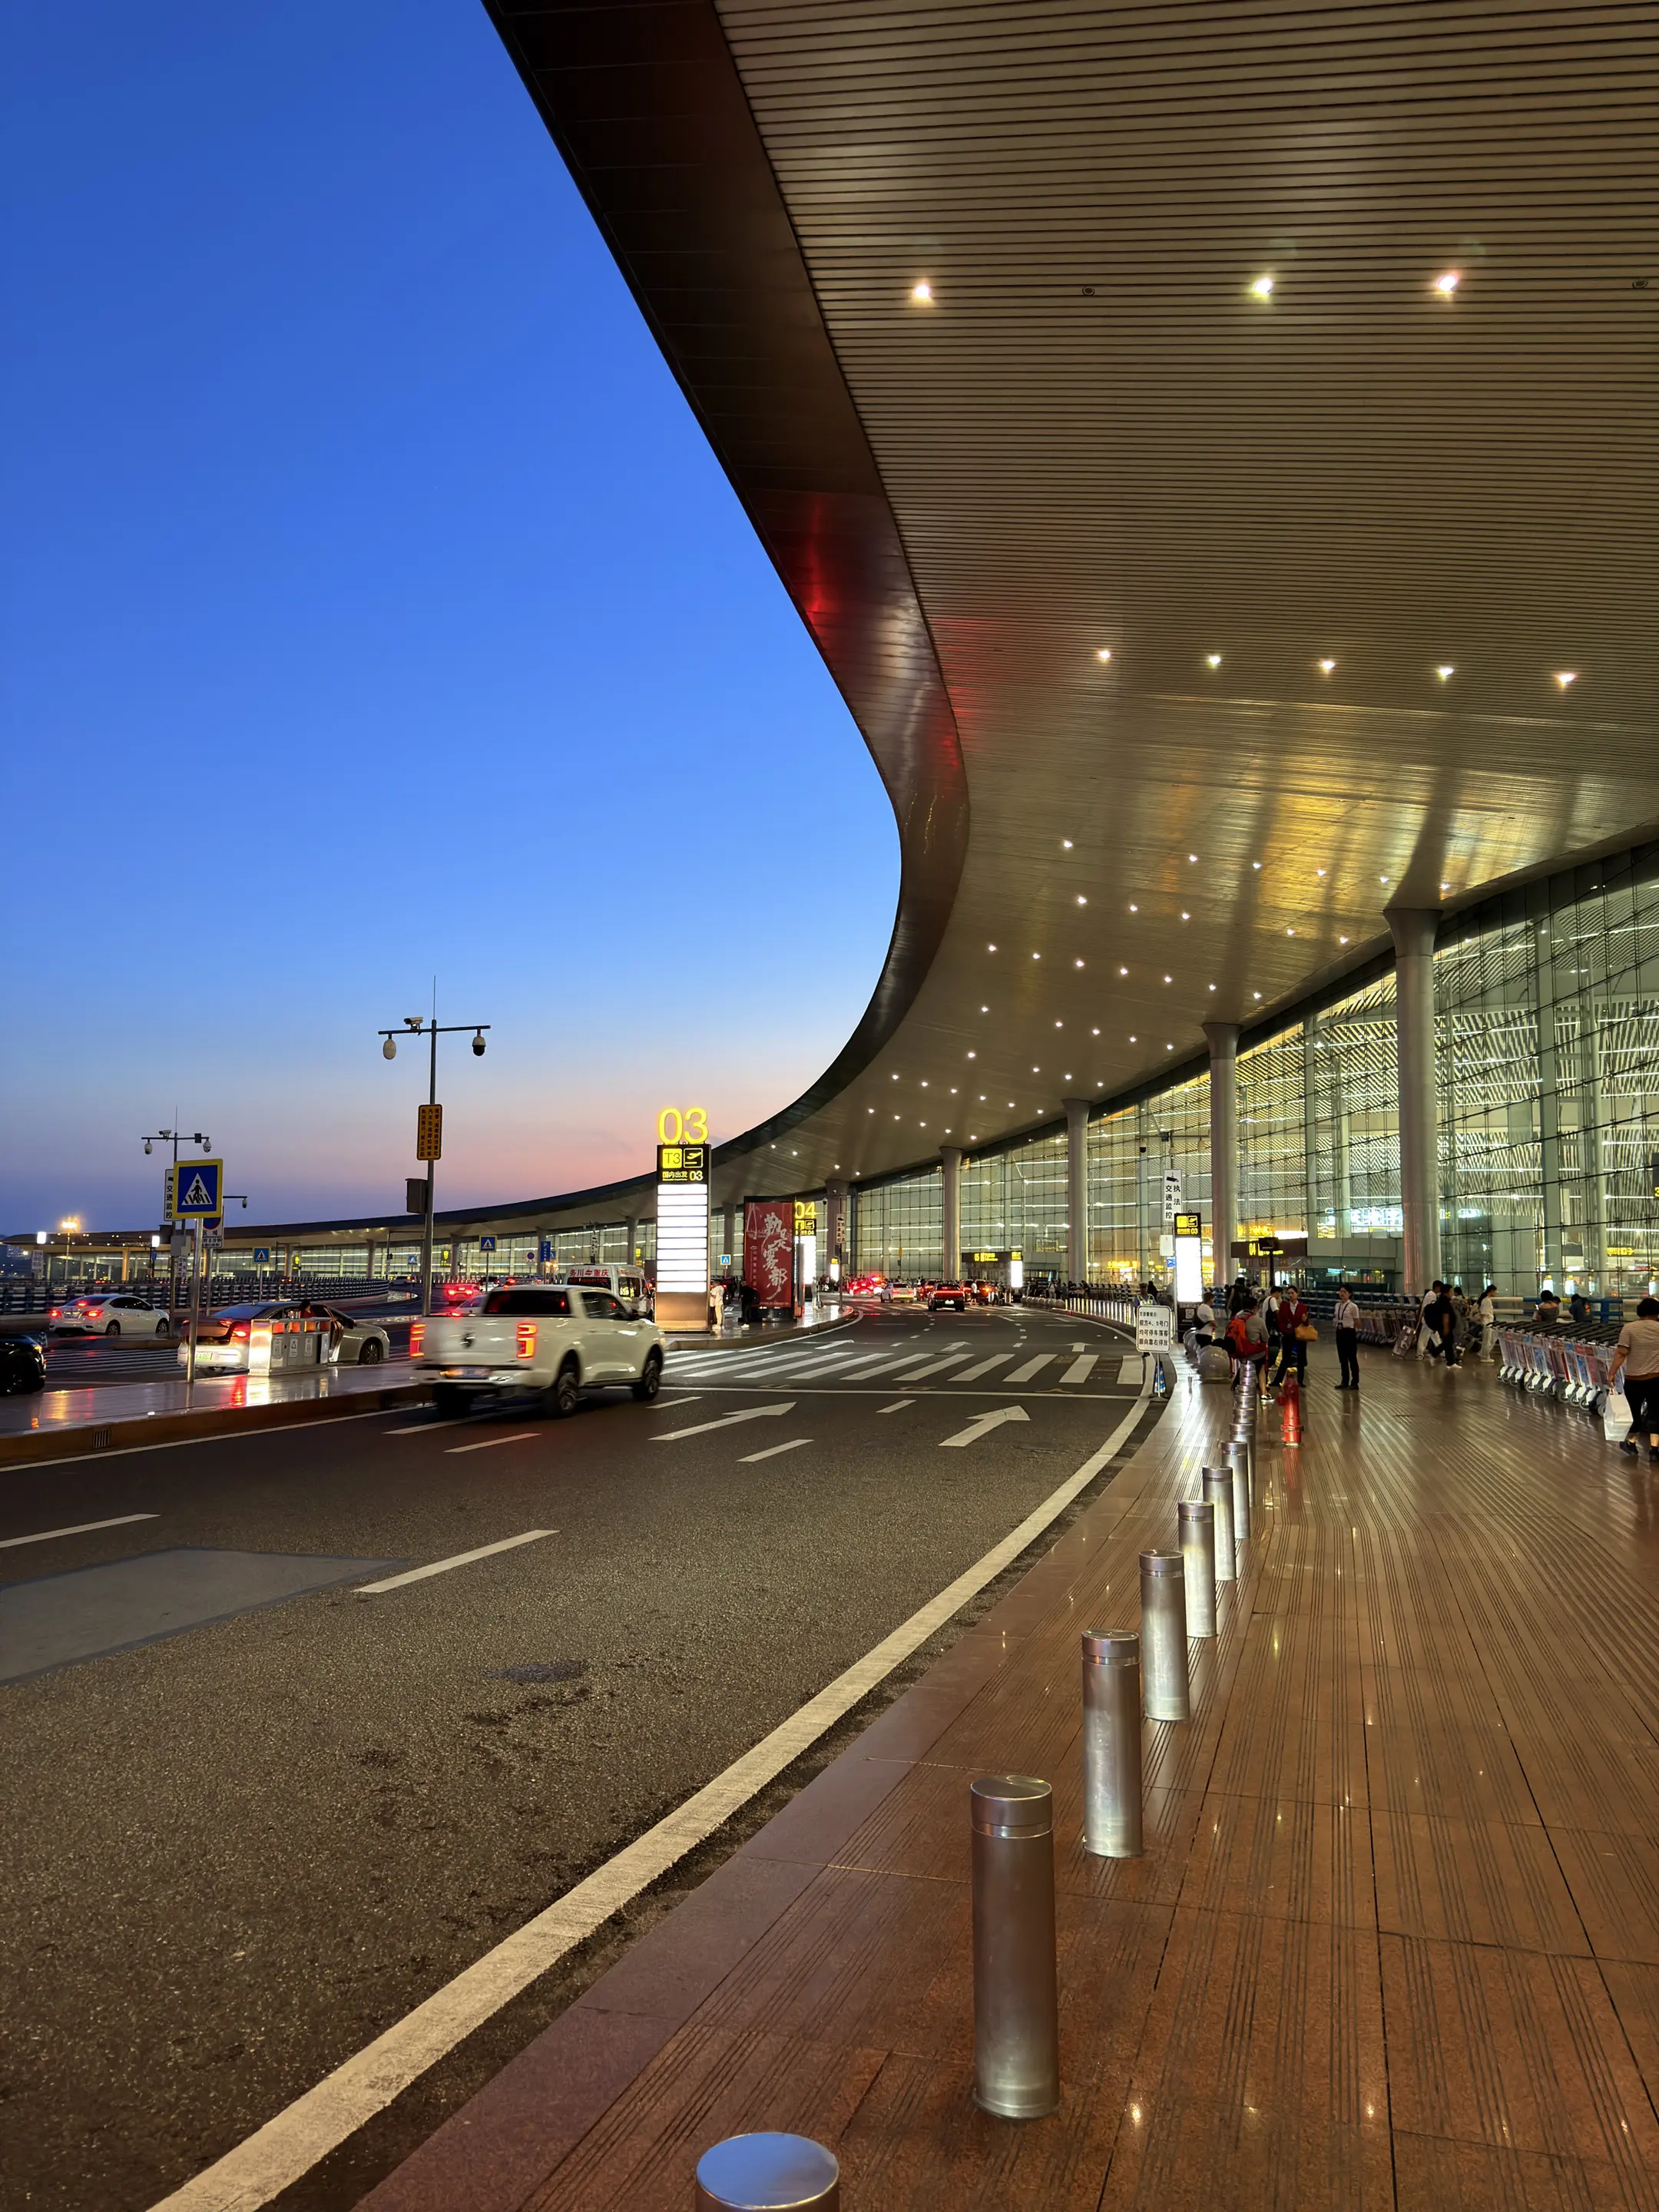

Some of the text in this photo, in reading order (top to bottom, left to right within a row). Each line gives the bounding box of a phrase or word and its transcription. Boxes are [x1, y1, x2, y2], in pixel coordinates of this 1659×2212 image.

[658, 1108, 708, 1144] 03
[664, 1153, 680, 1164] T3
[690, 1171, 704, 1181] 03
[795, 1202, 816, 1219] 04
